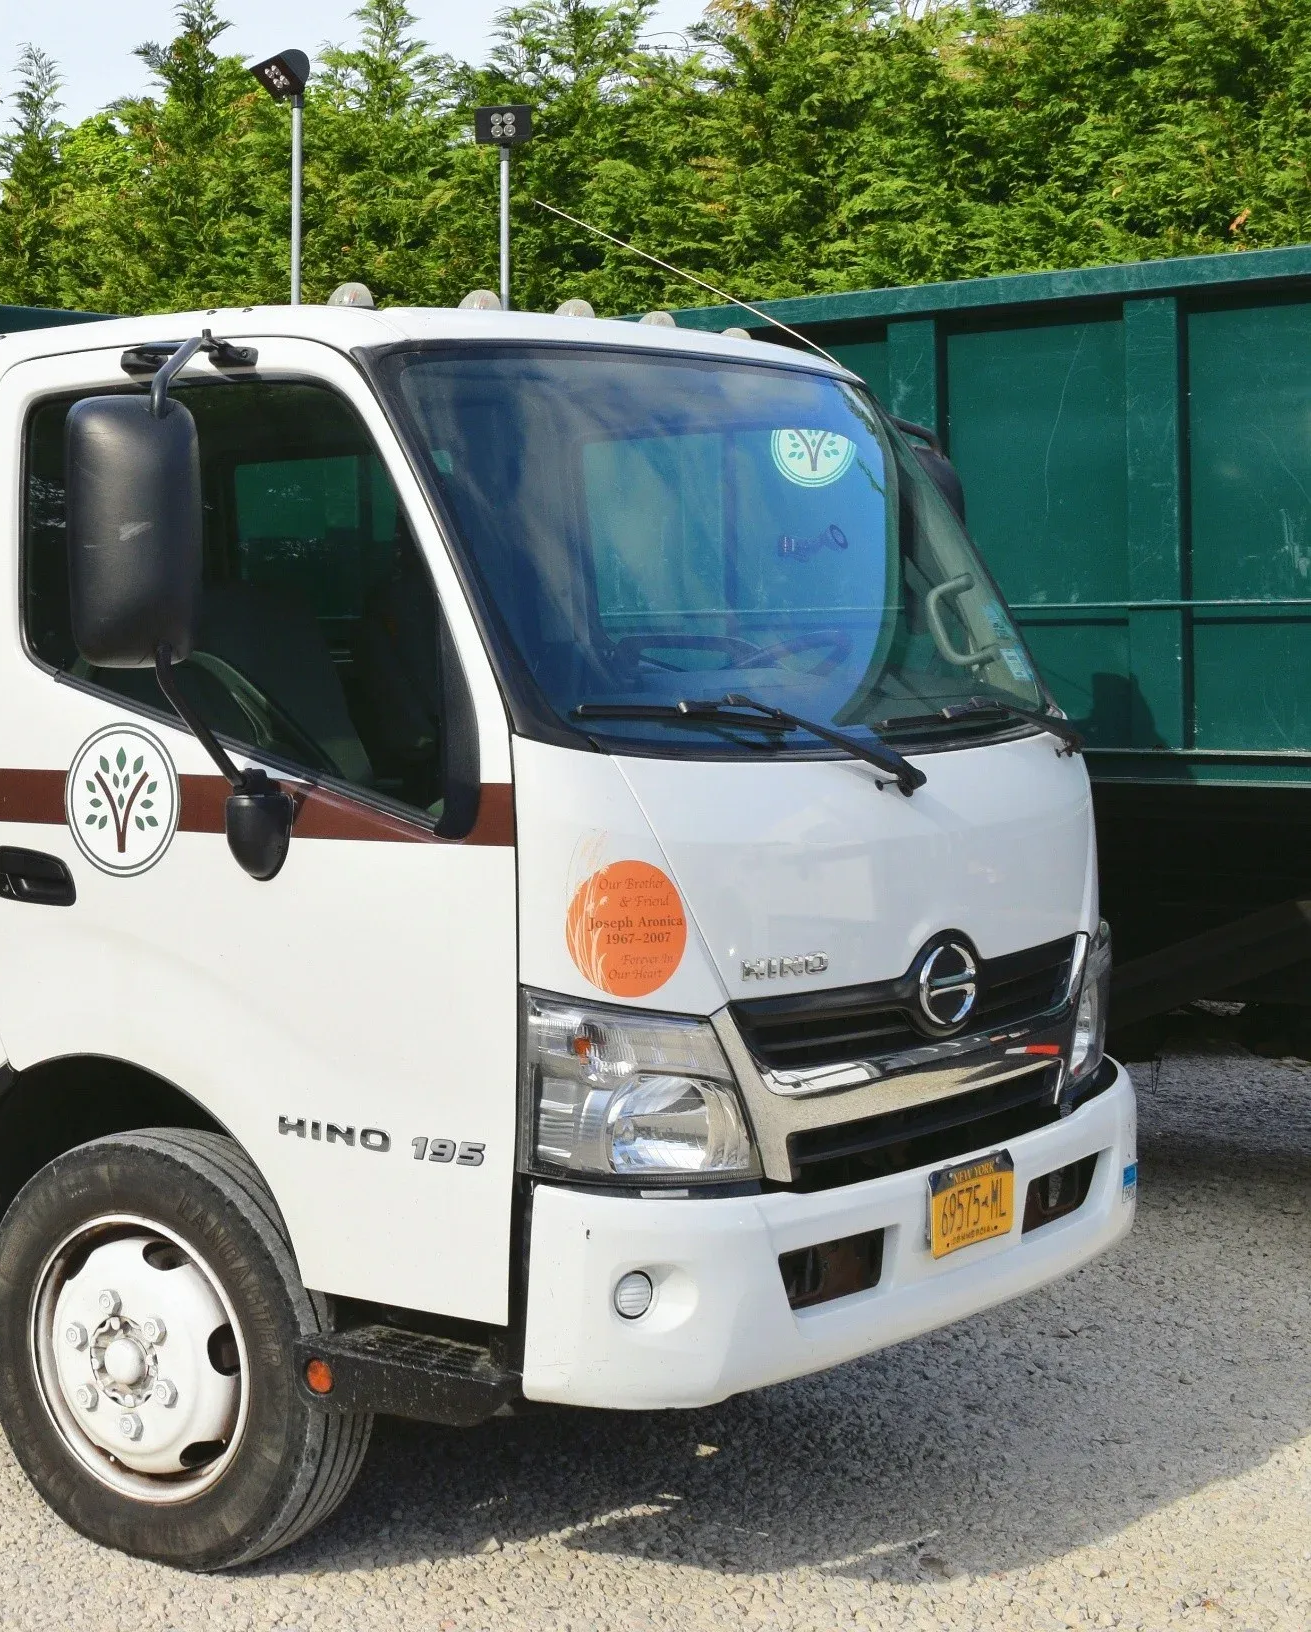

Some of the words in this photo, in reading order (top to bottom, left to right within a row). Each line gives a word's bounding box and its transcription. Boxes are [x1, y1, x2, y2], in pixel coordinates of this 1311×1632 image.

[599, 878, 621, 890] Our
[625, 875, 665, 889] Brother
[619, 896, 630, 907] &
[635, 893, 672, 907] Friend
[588, 917, 633, 932] Joseph
[638, 916, 683, 928] Aronica
[621, 954, 659, 966] Forever
[741, 950, 829, 982] HINO
[608, 970, 630, 980] Our
[278, 1114, 392, 1153] HINO
[411, 1136, 486, 1167] 195
[952, 1170, 972, 1184] NEW
[974, 1160, 995, 1177] YORK
